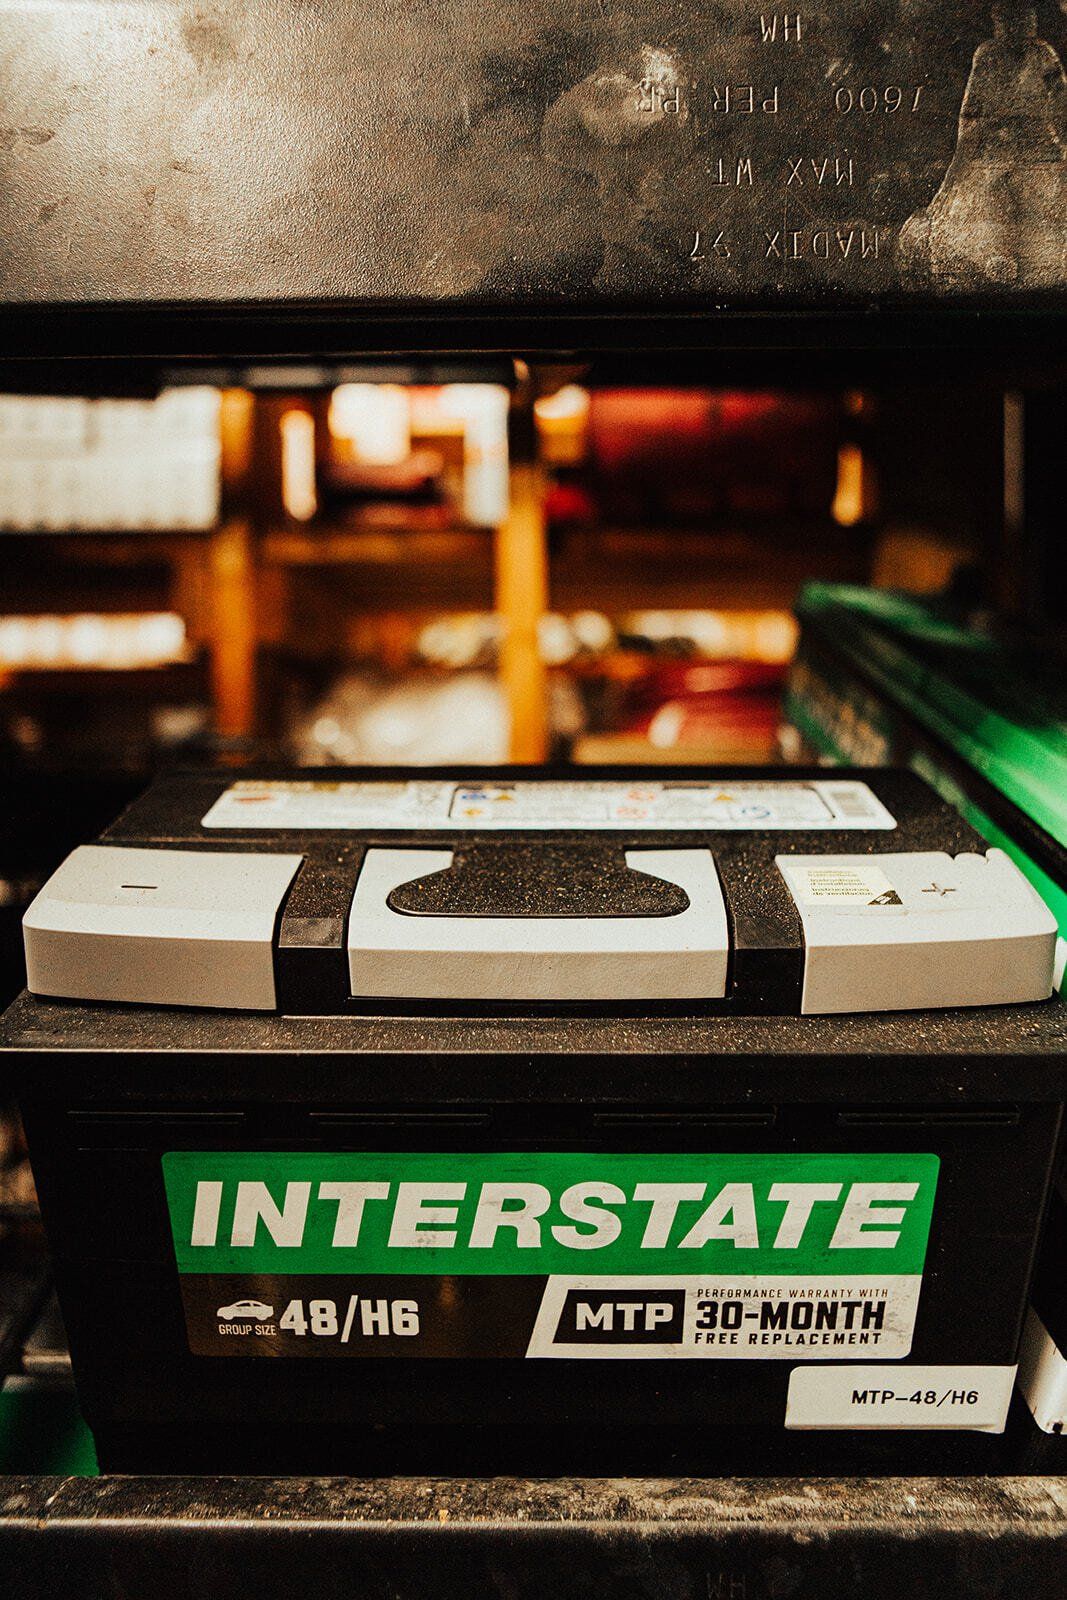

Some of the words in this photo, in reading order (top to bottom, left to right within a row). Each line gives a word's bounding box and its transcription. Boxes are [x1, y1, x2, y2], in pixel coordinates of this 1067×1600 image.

[712, 85, 779, 115] PER
[833, 85, 922, 114] 1600
[711, 157, 753, 187] WT
[786, 158, 854, 187] MAX
[689, 230, 732, 261] 97
[764, 230, 879, 260] MADIX
[190, 1180, 920, 1250] INTERSTATE
[697, 1288, 783, 1298] PERFORMANCE
[789, 1288, 854, 1298] WARRANTY
[859, 1288, 889, 1297] WITH
[218, 1323, 252, 1336] GROUP
[254, 1323, 277, 1336] SIZE
[279, 1295, 421, 1344] 48/H6
[575, 1302, 674, 1331] MTP
[695, 1300, 887, 1331] 30-MONTH
[694, 1332, 739, 1345] FREE
[748, 1332, 882, 1345] REPLACEMENT
[851, 1388, 980, 1406] MTP-48/H6
